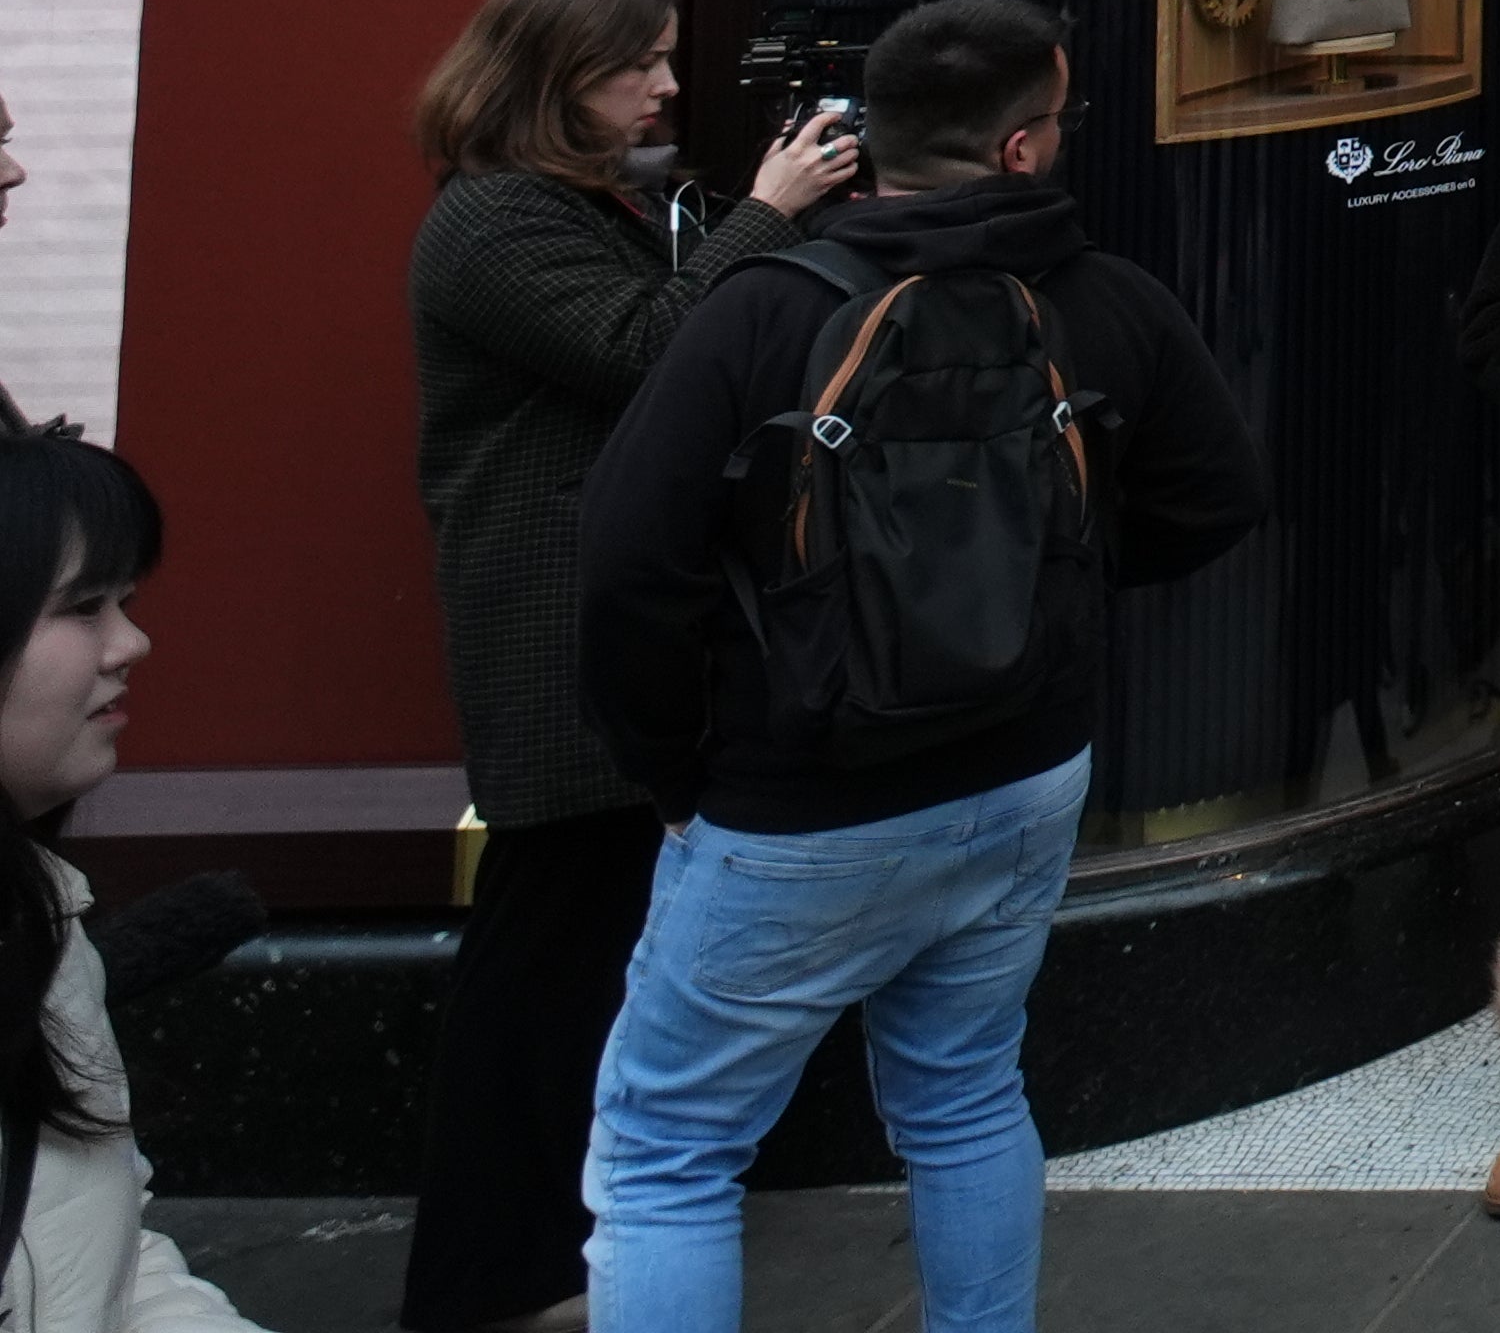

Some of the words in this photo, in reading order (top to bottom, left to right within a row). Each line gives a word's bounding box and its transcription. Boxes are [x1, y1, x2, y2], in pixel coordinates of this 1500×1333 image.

[1373, 140, 1431, 177] Loro
[1432, 131, 1486, 166] Piana
[1347, 192, 1390, 208] LUXURY
[1391, 181, 1457, 201] ACCESSORIES
